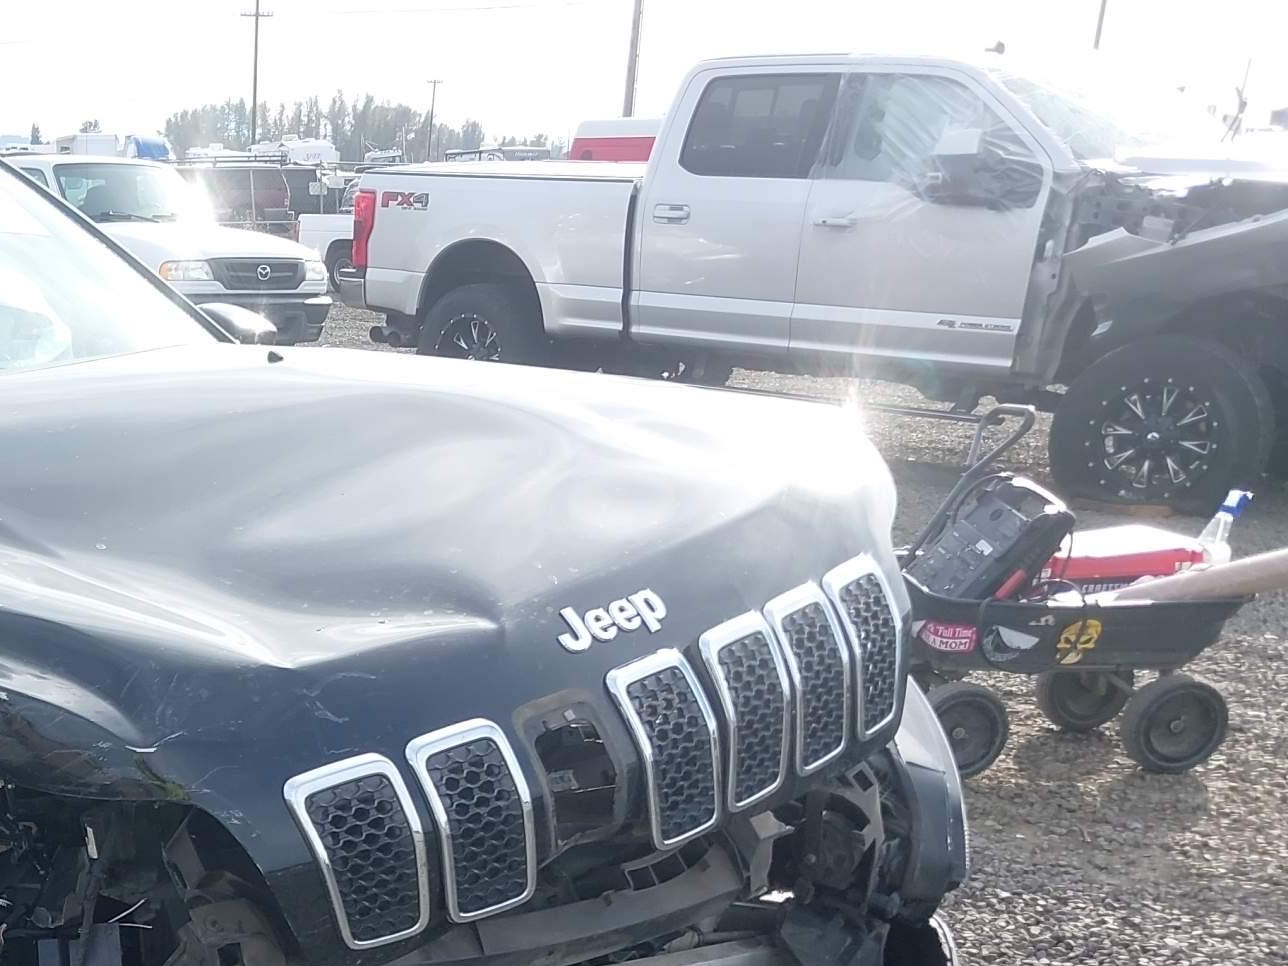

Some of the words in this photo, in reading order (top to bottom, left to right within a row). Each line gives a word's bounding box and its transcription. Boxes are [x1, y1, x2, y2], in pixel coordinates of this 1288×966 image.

[380, 191, 429, 208] FX4
[556, 588, 667, 654] Jeep
[938, 640, 969, 650] MOM
